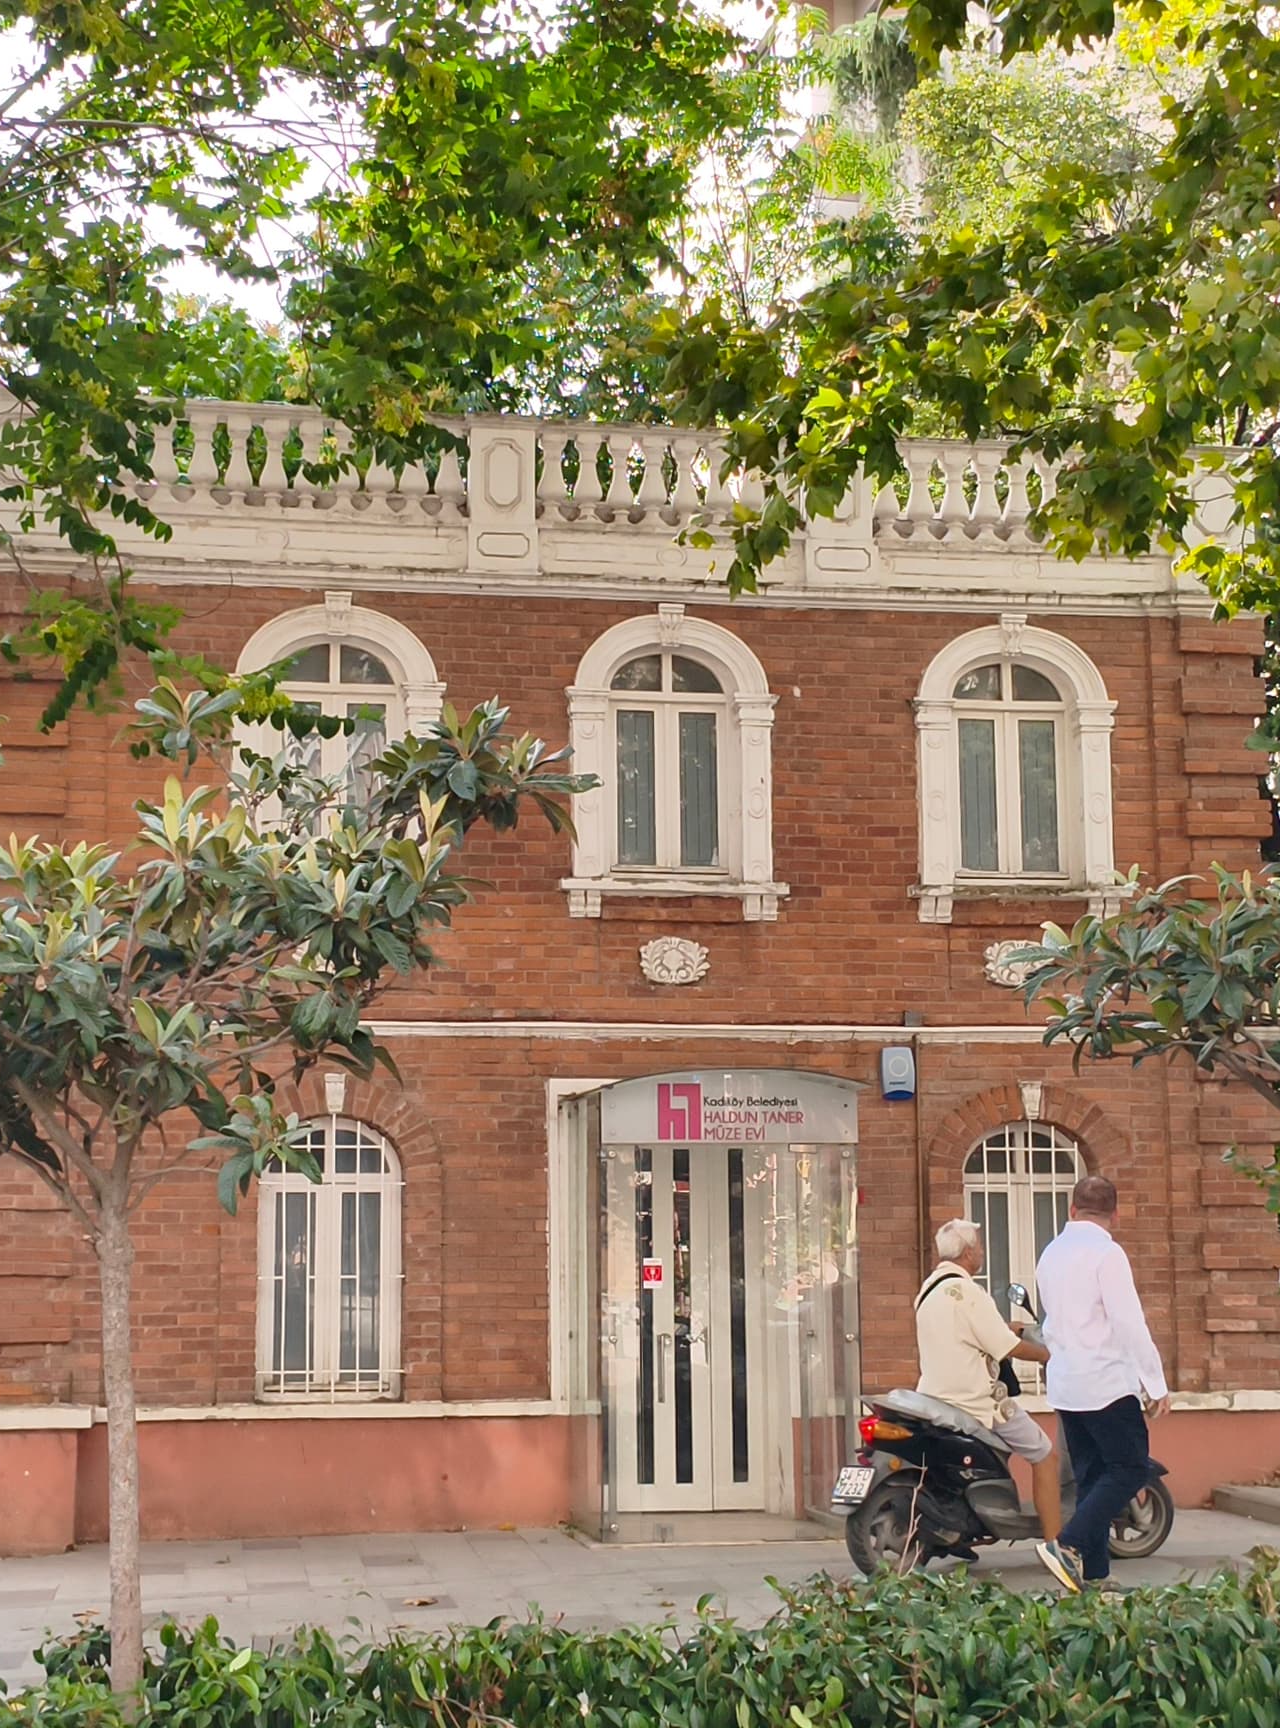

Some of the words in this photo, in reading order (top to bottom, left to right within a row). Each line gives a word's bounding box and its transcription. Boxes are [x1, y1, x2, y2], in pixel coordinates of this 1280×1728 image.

[746, 1096, 798, 1108] Belediyesi
[704, 1111, 758, 1124] HALDUN
[762, 1111, 804, 1124] TANER
[704, 1125, 741, 1141] MÜZE
[745, 1126, 765, 1141] EVİ
